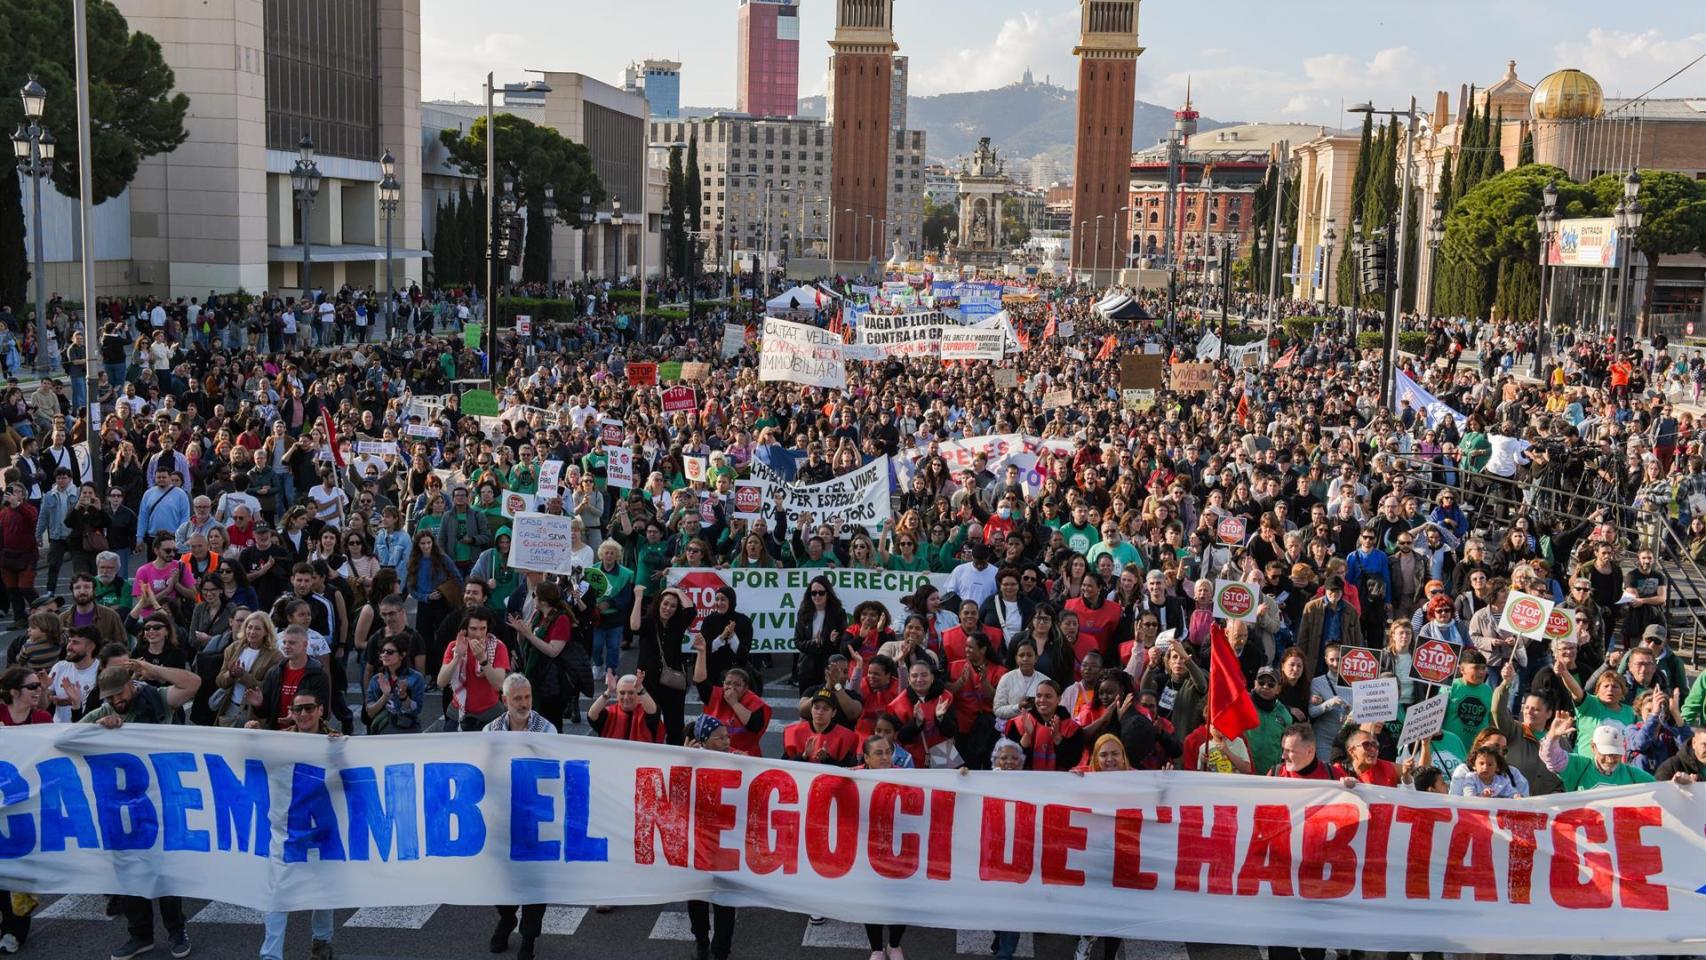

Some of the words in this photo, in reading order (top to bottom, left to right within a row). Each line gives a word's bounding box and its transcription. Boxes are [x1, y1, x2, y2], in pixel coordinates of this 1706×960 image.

[864, 316, 891, 330] VAGA
[894, 316, 909, 329] DE
[867, 330, 910, 345] CONTRA
[913, 328, 926, 340] LA
[630, 366, 653, 376] STOP
[762, 354, 838, 379] IMMOBILIARI
[669, 388, 687, 398] STOP
[610, 450, 619, 458] NO
[610, 457, 618, 466] ME
[609, 465, 623, 473] PIRO
[737, 493, 759, 501] STOP
[789, 493, 812, 508] PER
[1221, 524, 1242, 534] STOP
[732, 571, 779, 588] POR
[787, 571, 809, 588] EL
[823, 570, 931, 592] DERECHO
[780, 592, 795, 608] A
[1224, 591, 1250, 603] STOP
[1514, 603, 1541, 618] STOP
[1548, 616, 1568, 626] TOP
[1418, 648, 1454, 667] STOP
[1344, 657, 1376, 673] STOP
[1416, 660, 1451, 674] DESAHUCIOS
[1343, 669, 1375, 678] DESAHUCIOS
[1413, 698, 1441, 715] 20.000
[1460, 702, 1485, 715] STOP
[1433, 759, 1460, 770] SOP
[284, 762, 486, 862] AMB
[510, 758, 608, 862] EL
[634, 766, 956, 881] NEGOCI
[978, 795, 1093, 888] DE
[1112, 803, 1669, 911] L'HABITATGE
